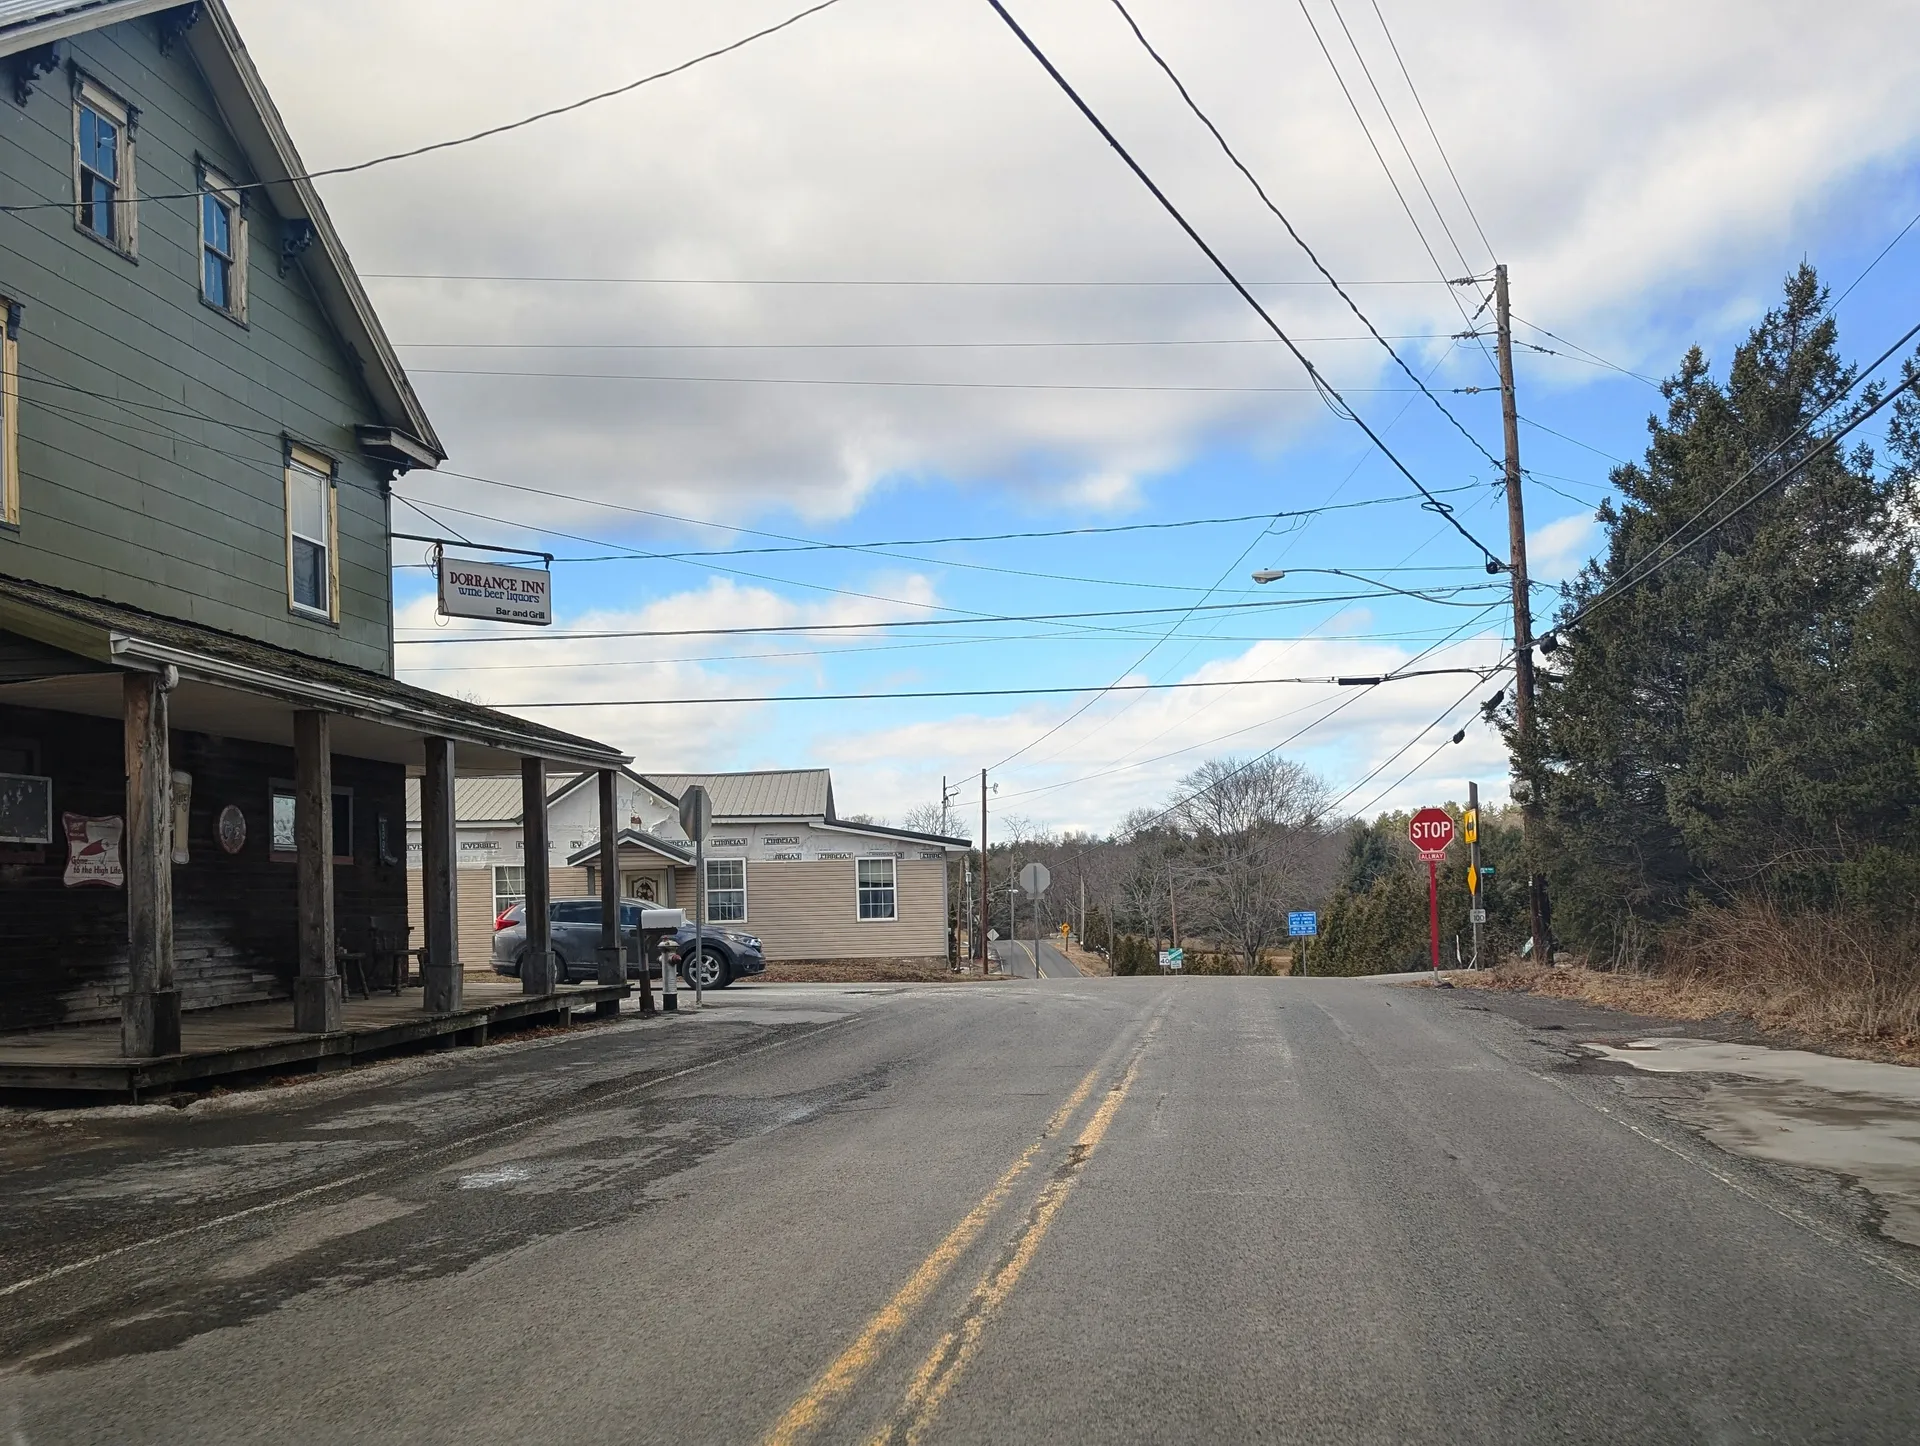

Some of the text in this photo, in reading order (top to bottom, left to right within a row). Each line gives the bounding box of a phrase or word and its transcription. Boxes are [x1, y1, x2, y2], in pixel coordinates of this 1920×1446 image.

[449, 571, 545, 594] DORRANCE INN
[458, 587, 540, 603] wine beer liquors
[495, 607, 545, 619] Bar and Grill
[1412, 821, 1450, 839] STOP
[462, 842, 497, 850] EVERBILT
[73, 866, 80, 874] to
[82, 865, 92, 874] the
[94, 865, 108, 876] High
